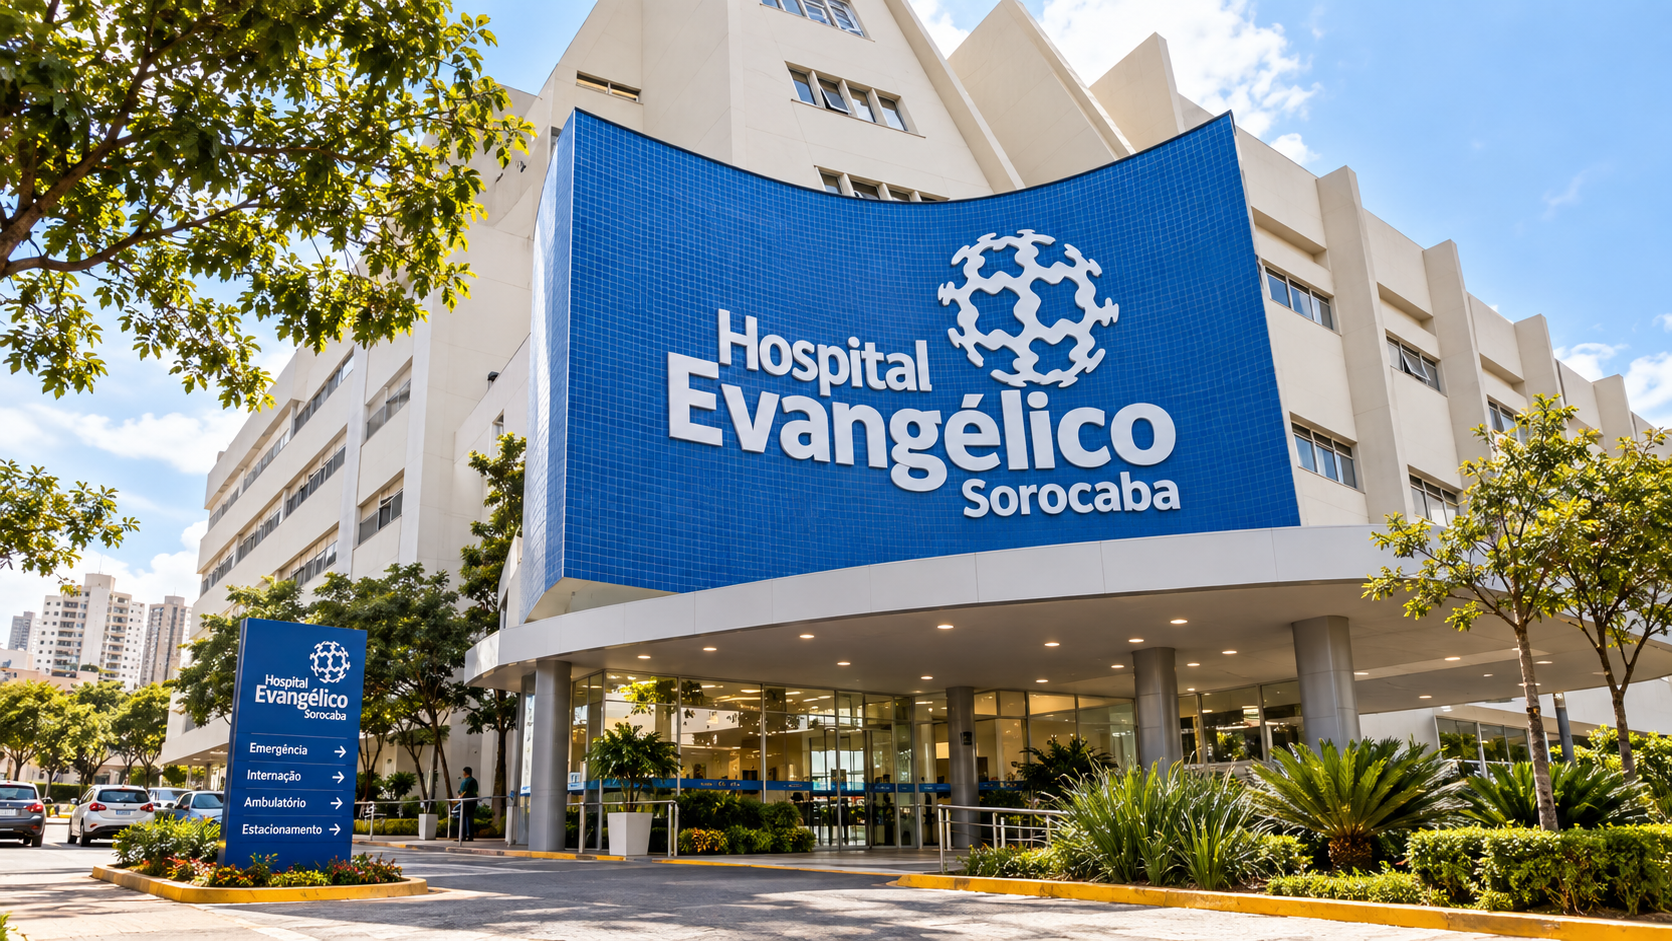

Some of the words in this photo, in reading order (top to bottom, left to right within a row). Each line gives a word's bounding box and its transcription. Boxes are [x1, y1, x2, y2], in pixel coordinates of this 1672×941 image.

[718, 309, 933, 396] Hospital
[668, 352, 1177, 491] Evangélico
[962, 472, 1181, 518] Sorocaba
[265, 674, 308, 690] Hospital
[255, 685, 349, 710] Evangélico
[304, 709, 347, 721] Sorocaba
[247, 769, 302, 783] Internação
[244, 796, 307, 808] Ambulatório
[242, 823, 323, 835] Estacionamento
